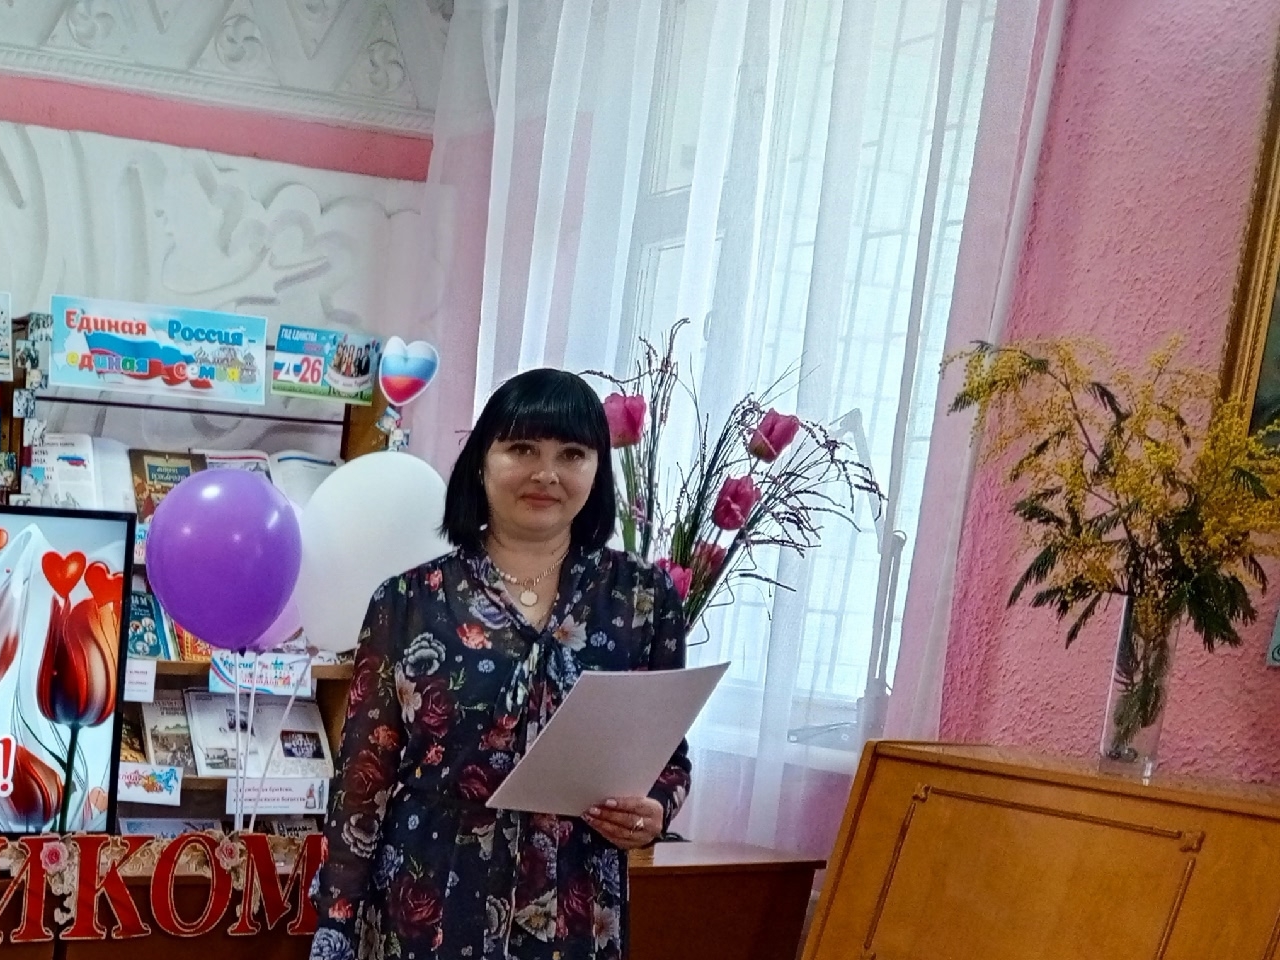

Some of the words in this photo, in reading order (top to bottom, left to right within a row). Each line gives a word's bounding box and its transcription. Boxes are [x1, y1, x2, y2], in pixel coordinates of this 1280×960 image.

[65, 310, 148, 336] Единая
[167, 318, 244, 346] Россия
[66, 351, 150, 373] единая
[174, 361, 240, 382] семья
